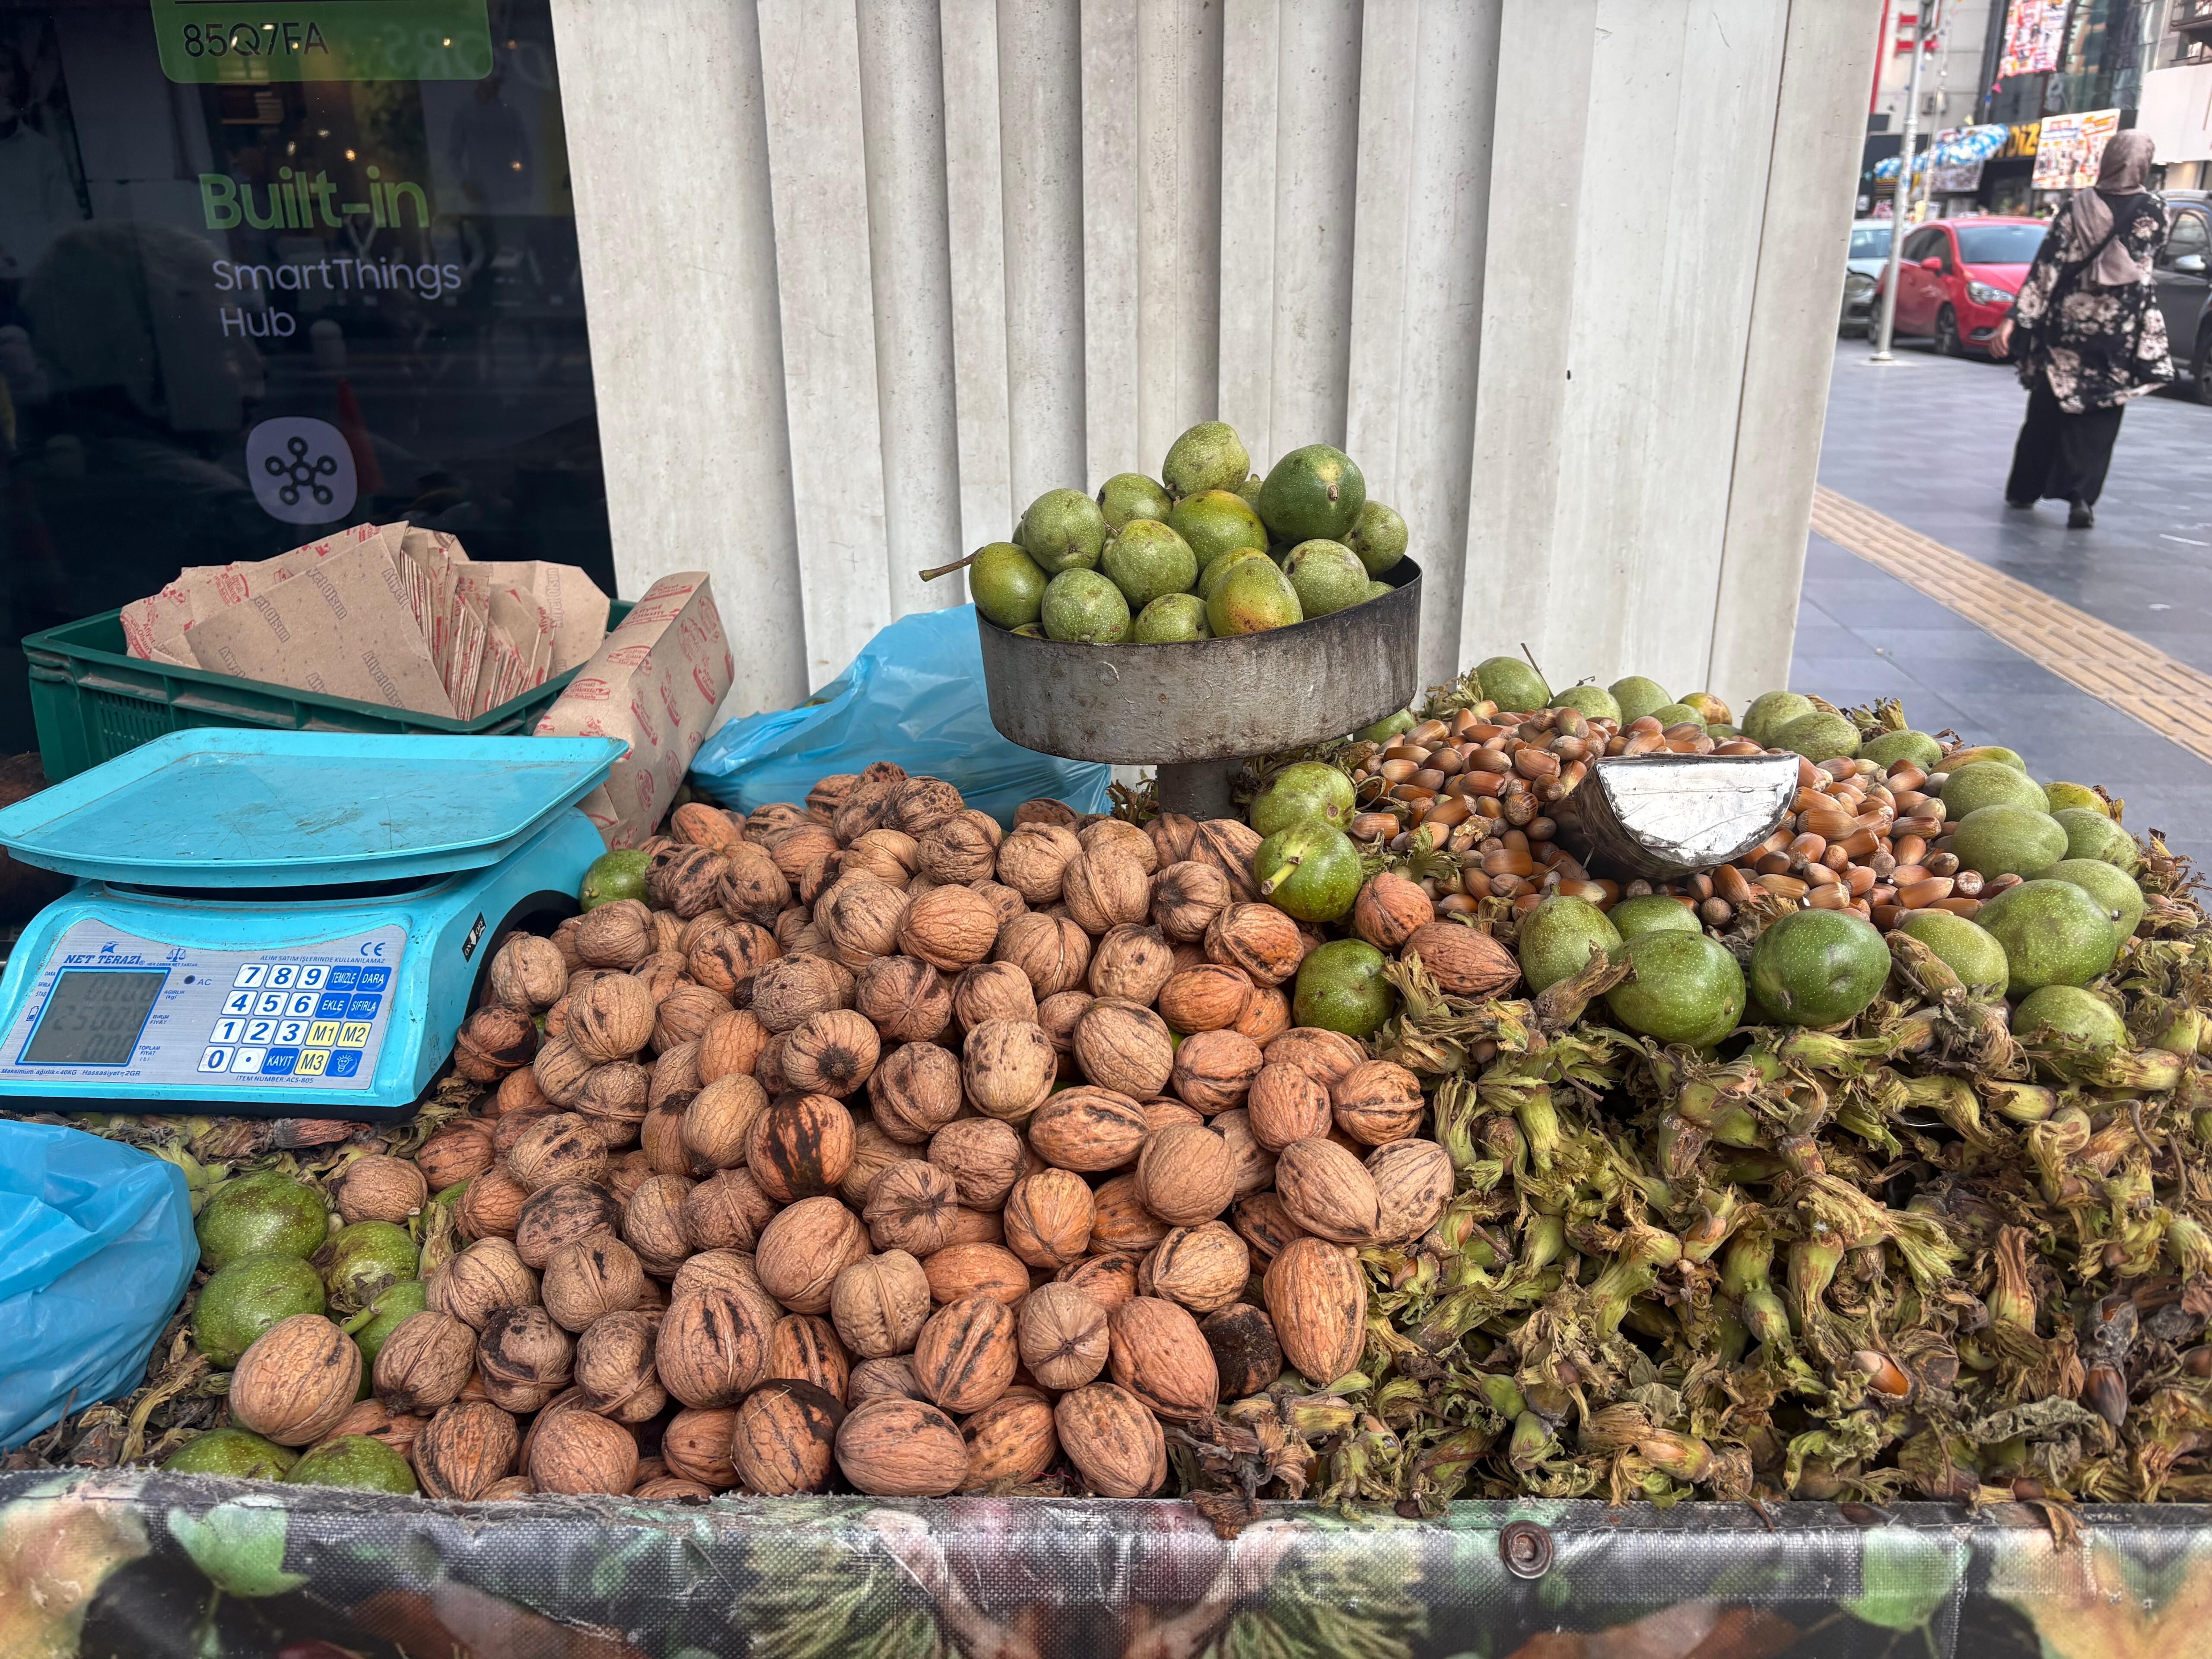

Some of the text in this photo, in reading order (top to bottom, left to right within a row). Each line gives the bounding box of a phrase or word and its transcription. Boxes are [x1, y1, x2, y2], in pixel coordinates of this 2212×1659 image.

[183, 22, 329, 57] 85Q7FA
[199, 165, 429, 229] Built-in
[212, 257, 462, 300] SmartThings
[220, 306, 296, 337] Hub
[360, 942, 385, 956] CE
[465, 943, 472, 956] ON
[64, 955, 95, 963] NET
[245, 967, 260, 984] 7
[274, 968, 291, 985] 8
[304, 969, 321, 985] 9
[362, 973, 385, 984] DARA
[231, 995, 248, 1011] 4
[263, 995, 281, 1012] 5
[294, 996, 312, 1013] 6
[322, 1000, 344, 1011] EKLE
[351, 1001, 375, 1012] SIFIRLA
[223, 1022, 235, 1039] 1
[250, 1023, 270, 1041] 2
[282, 1023, 300, 1042] 3
[312, 1026, 334, 1041] M1
[343, 1027, 366, 1043] M2
[208, 1050, 224, 1069] 0
[266, 1055, 294, 1067] KAYIT
[302, 1054, 324, 1071] M3
